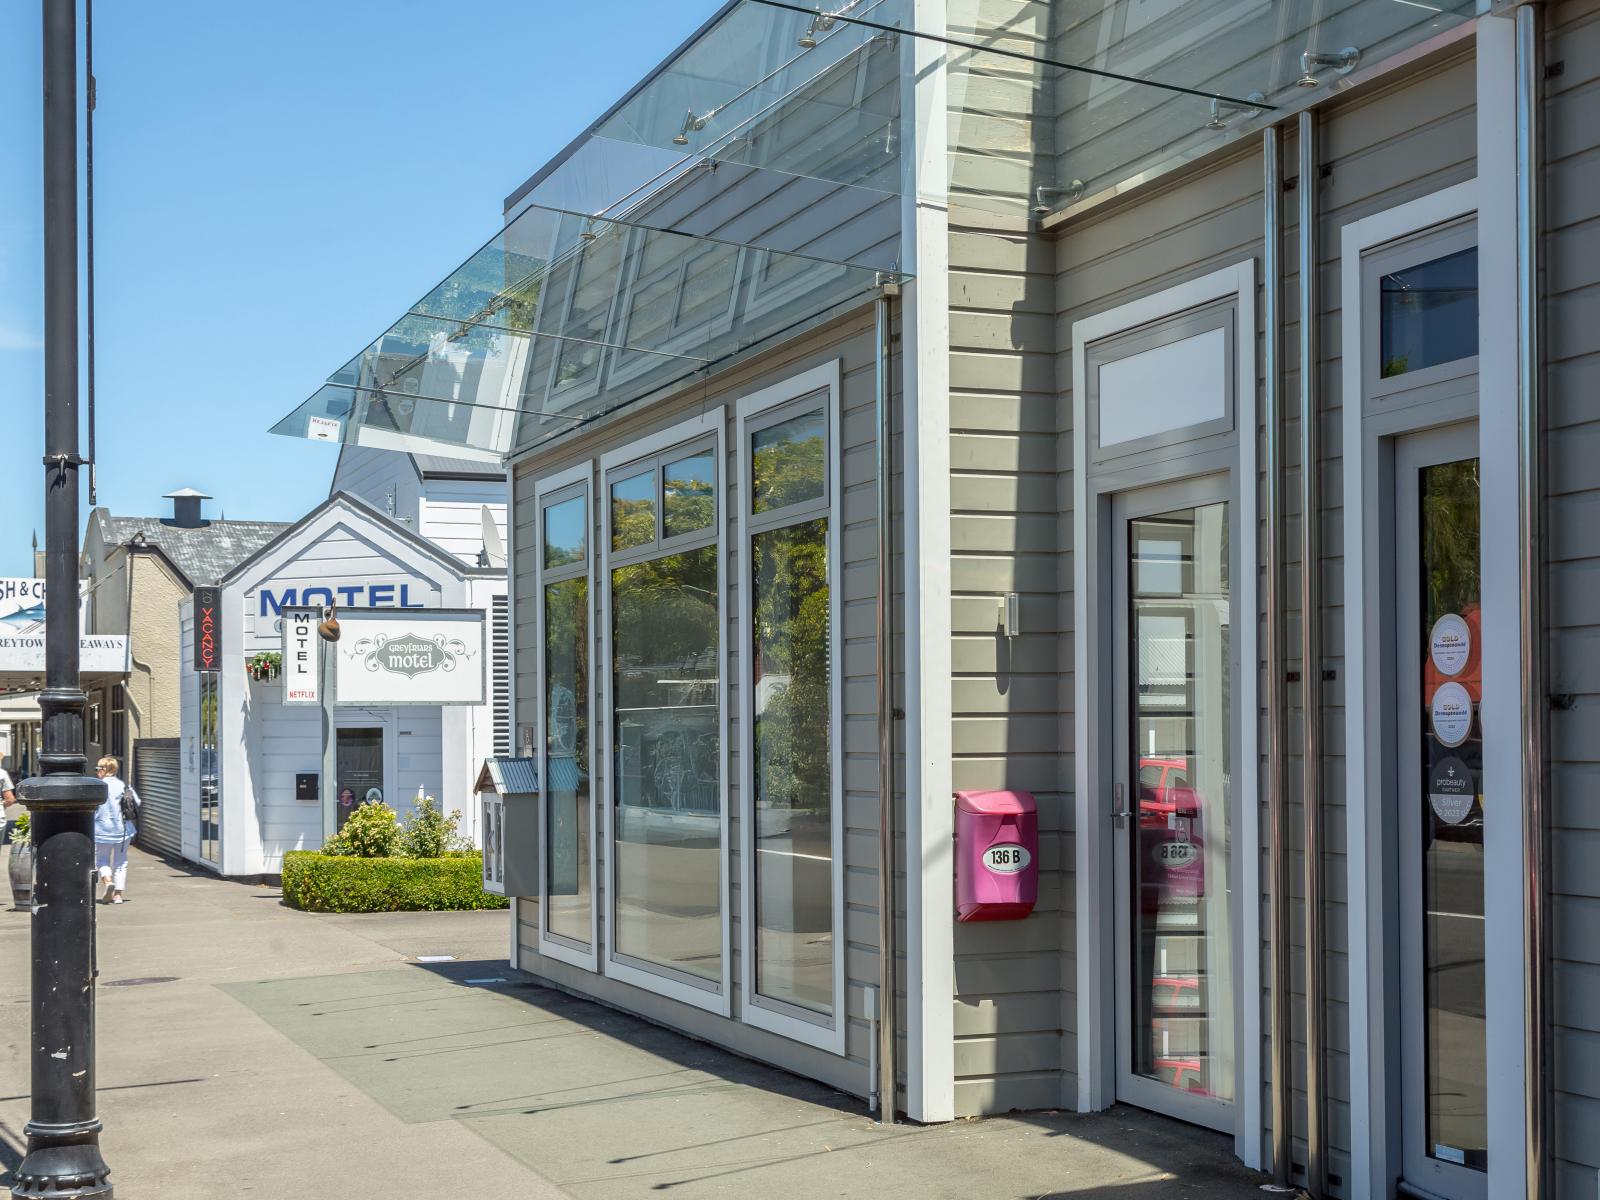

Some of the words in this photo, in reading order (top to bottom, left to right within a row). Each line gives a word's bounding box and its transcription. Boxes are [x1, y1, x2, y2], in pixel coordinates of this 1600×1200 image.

[20, 581, 29, 597] &
[260, 584, 425, 617] MOTEL
[202, 607, 213, 668] VACANCY
[294, 613, 310, 674] MOTEL
[388, 653, 434, 668] motel
[289, 690, 315, 699] NETFLIX
[991, 850, 1011, 865] 136
[1012, 849, 1021, 864] B
